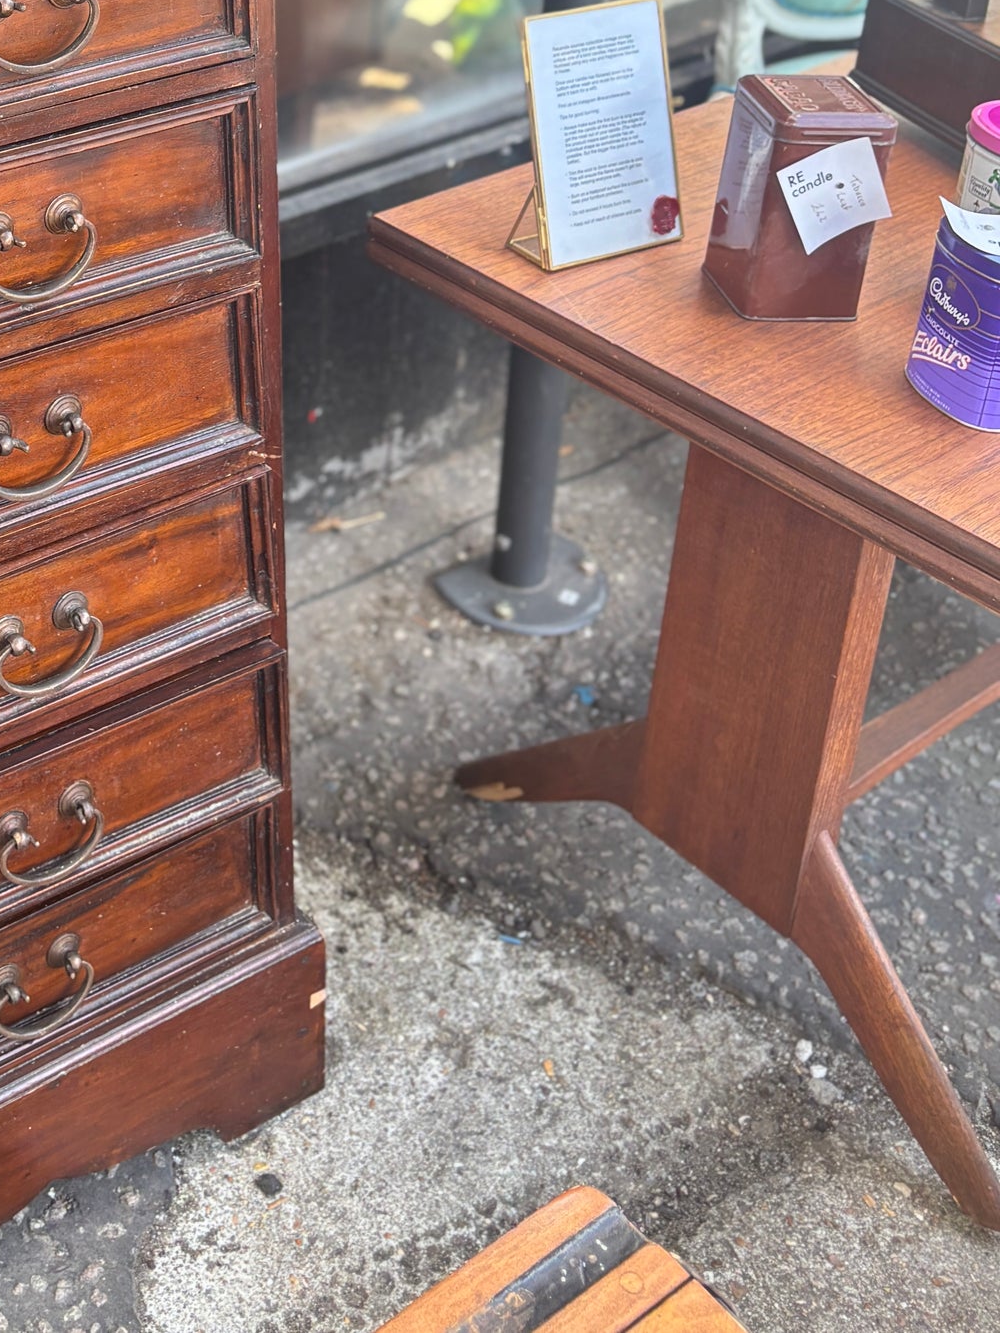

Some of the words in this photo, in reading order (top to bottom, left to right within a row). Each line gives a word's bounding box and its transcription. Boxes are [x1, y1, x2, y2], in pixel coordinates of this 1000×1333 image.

[788, 171, 805, 187] RE
[792, 171, 833, 197] candle
[929, 277, 970, 326] Cadbury's
[925, 314, 959, 346] CHOCOLATE
[911, 329, 971, 370] Eclairs
